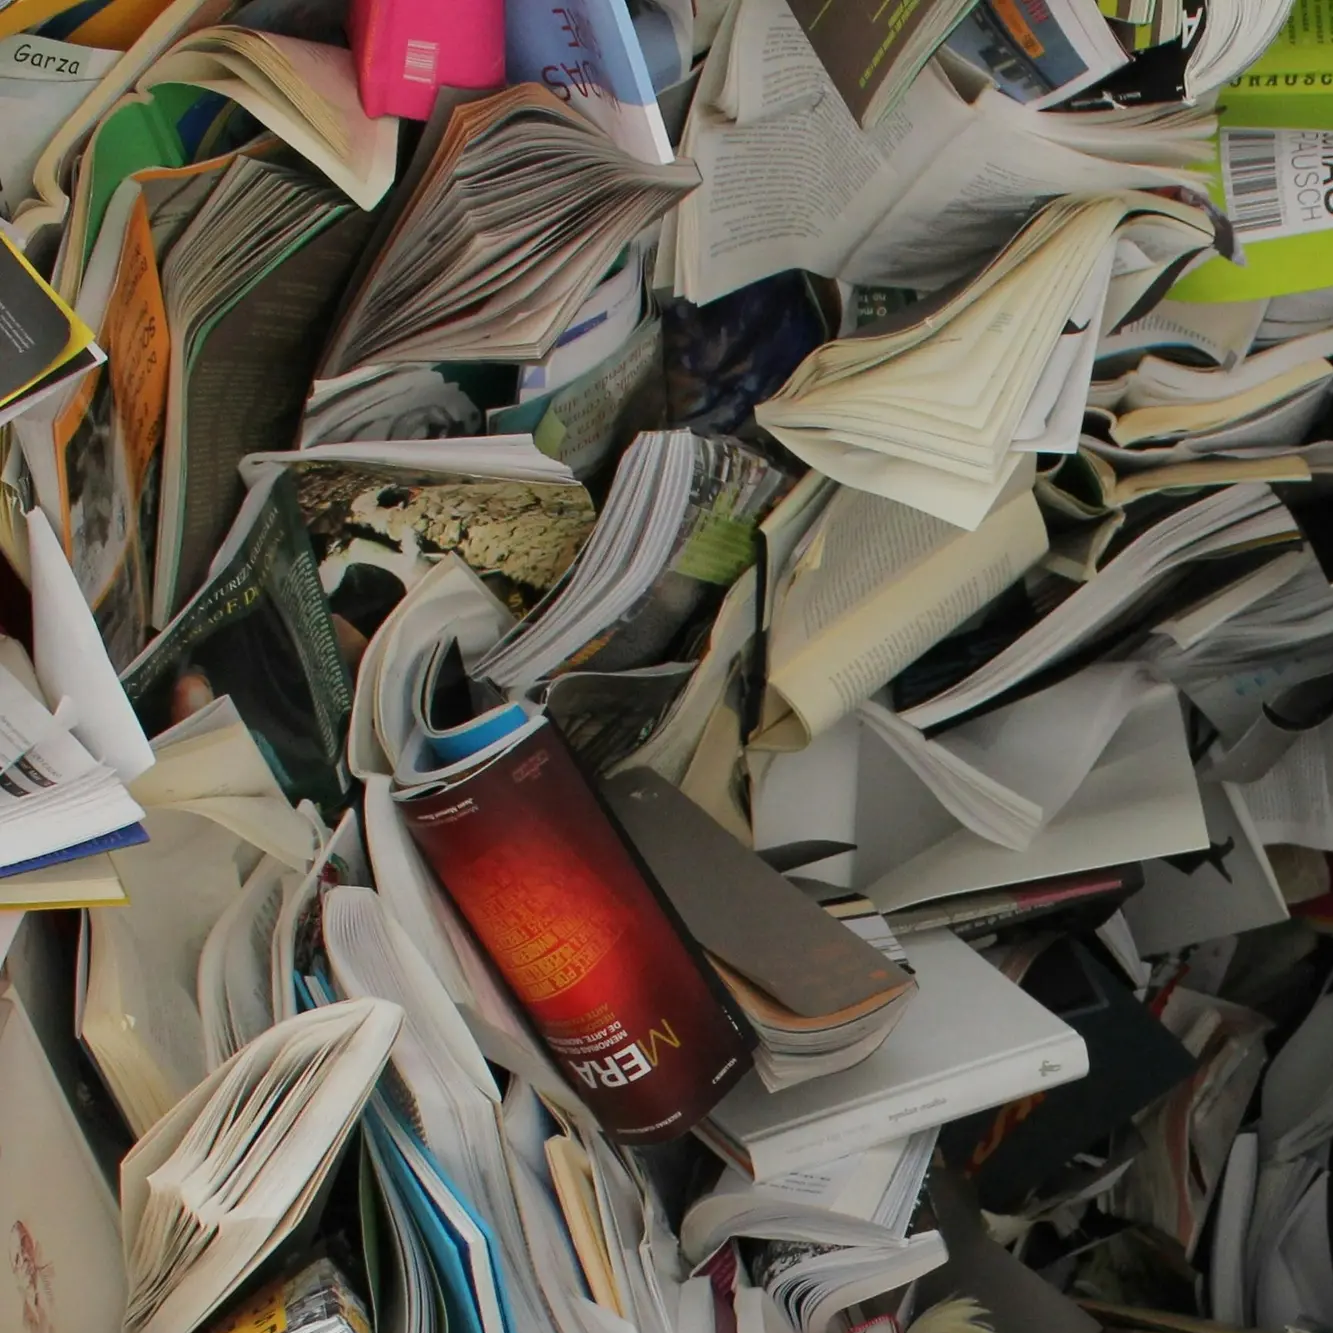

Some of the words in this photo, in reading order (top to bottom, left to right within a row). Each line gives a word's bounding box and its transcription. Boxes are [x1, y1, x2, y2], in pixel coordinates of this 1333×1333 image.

[12, 43, 81, 76] Garza
[1289, 131, 1321, 222] RAUSCH
[568, 1018, 681, 1089] MERA
